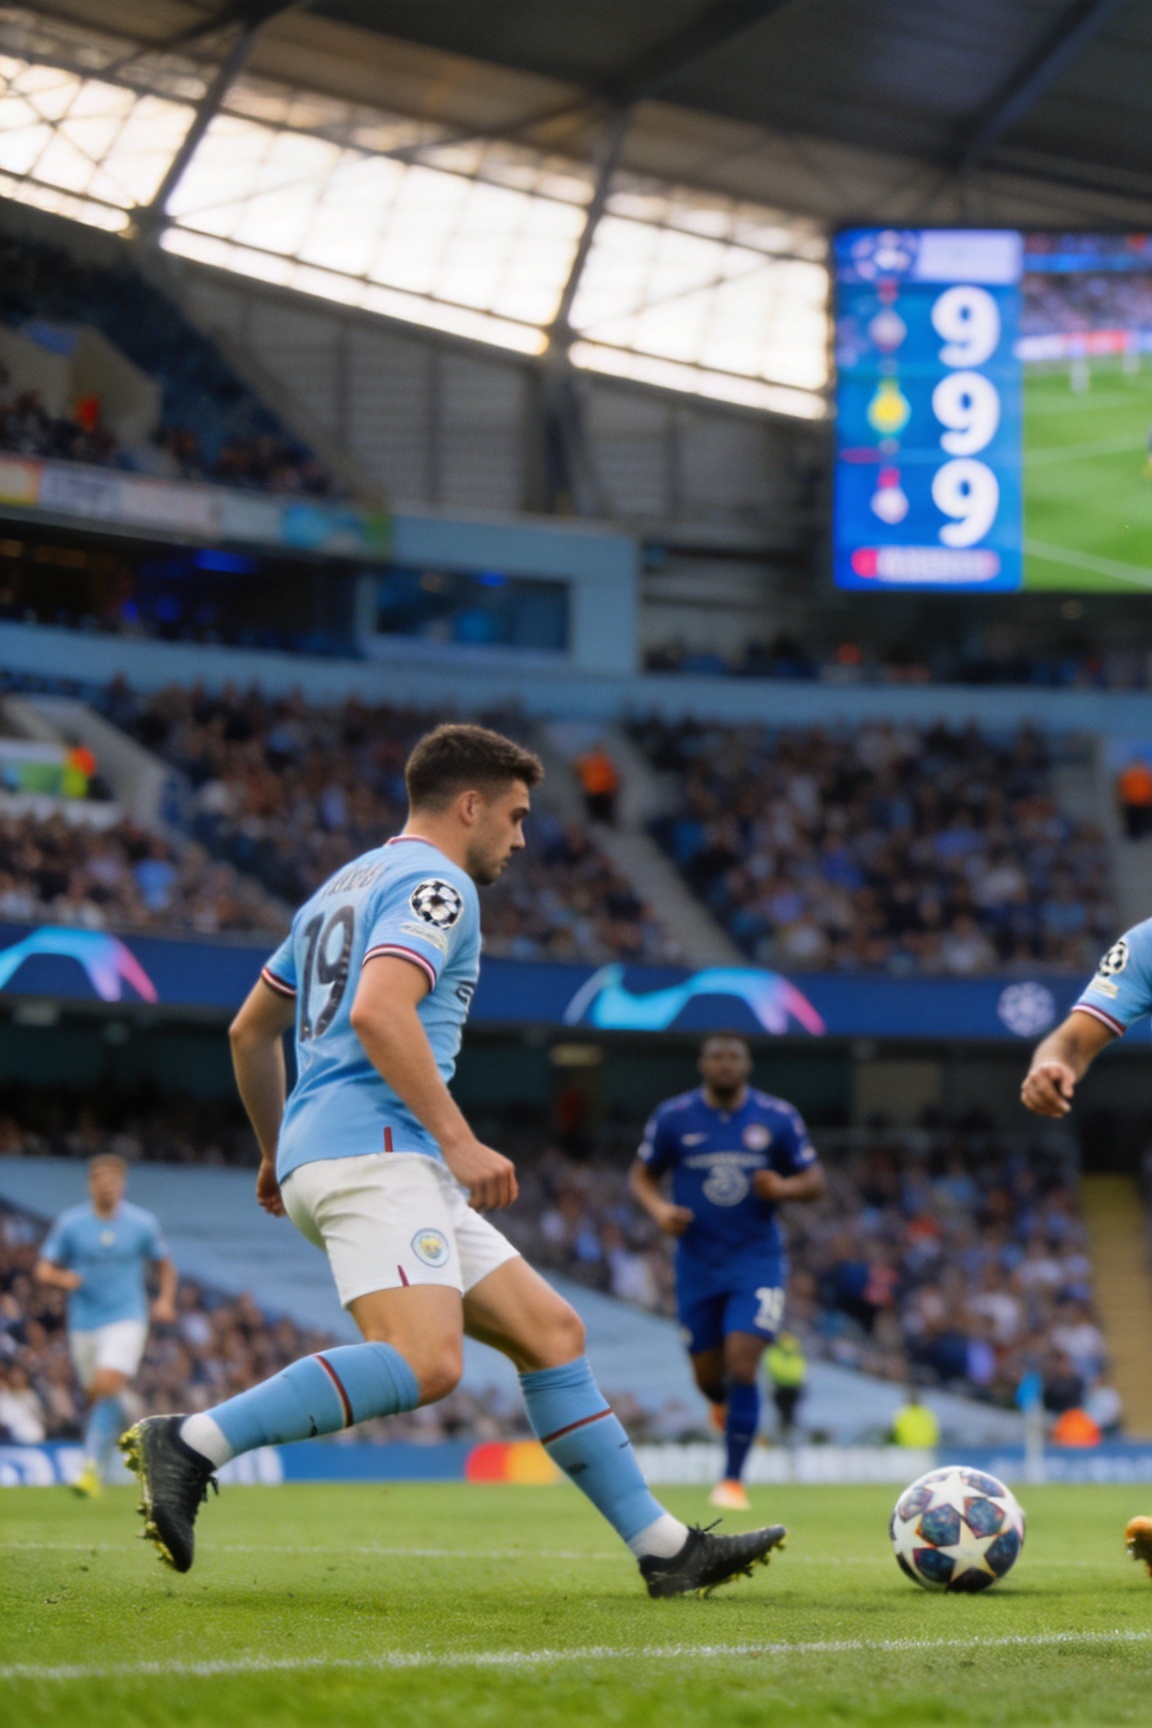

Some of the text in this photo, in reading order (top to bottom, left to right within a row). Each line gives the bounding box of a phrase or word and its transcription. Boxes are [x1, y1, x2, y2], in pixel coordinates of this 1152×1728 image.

[931, 285, 1000, 368] 9
[931, 371, 999, 456] 9
[931, 457, 999, 547] 9
[300, 905, 354, 1042] 19
